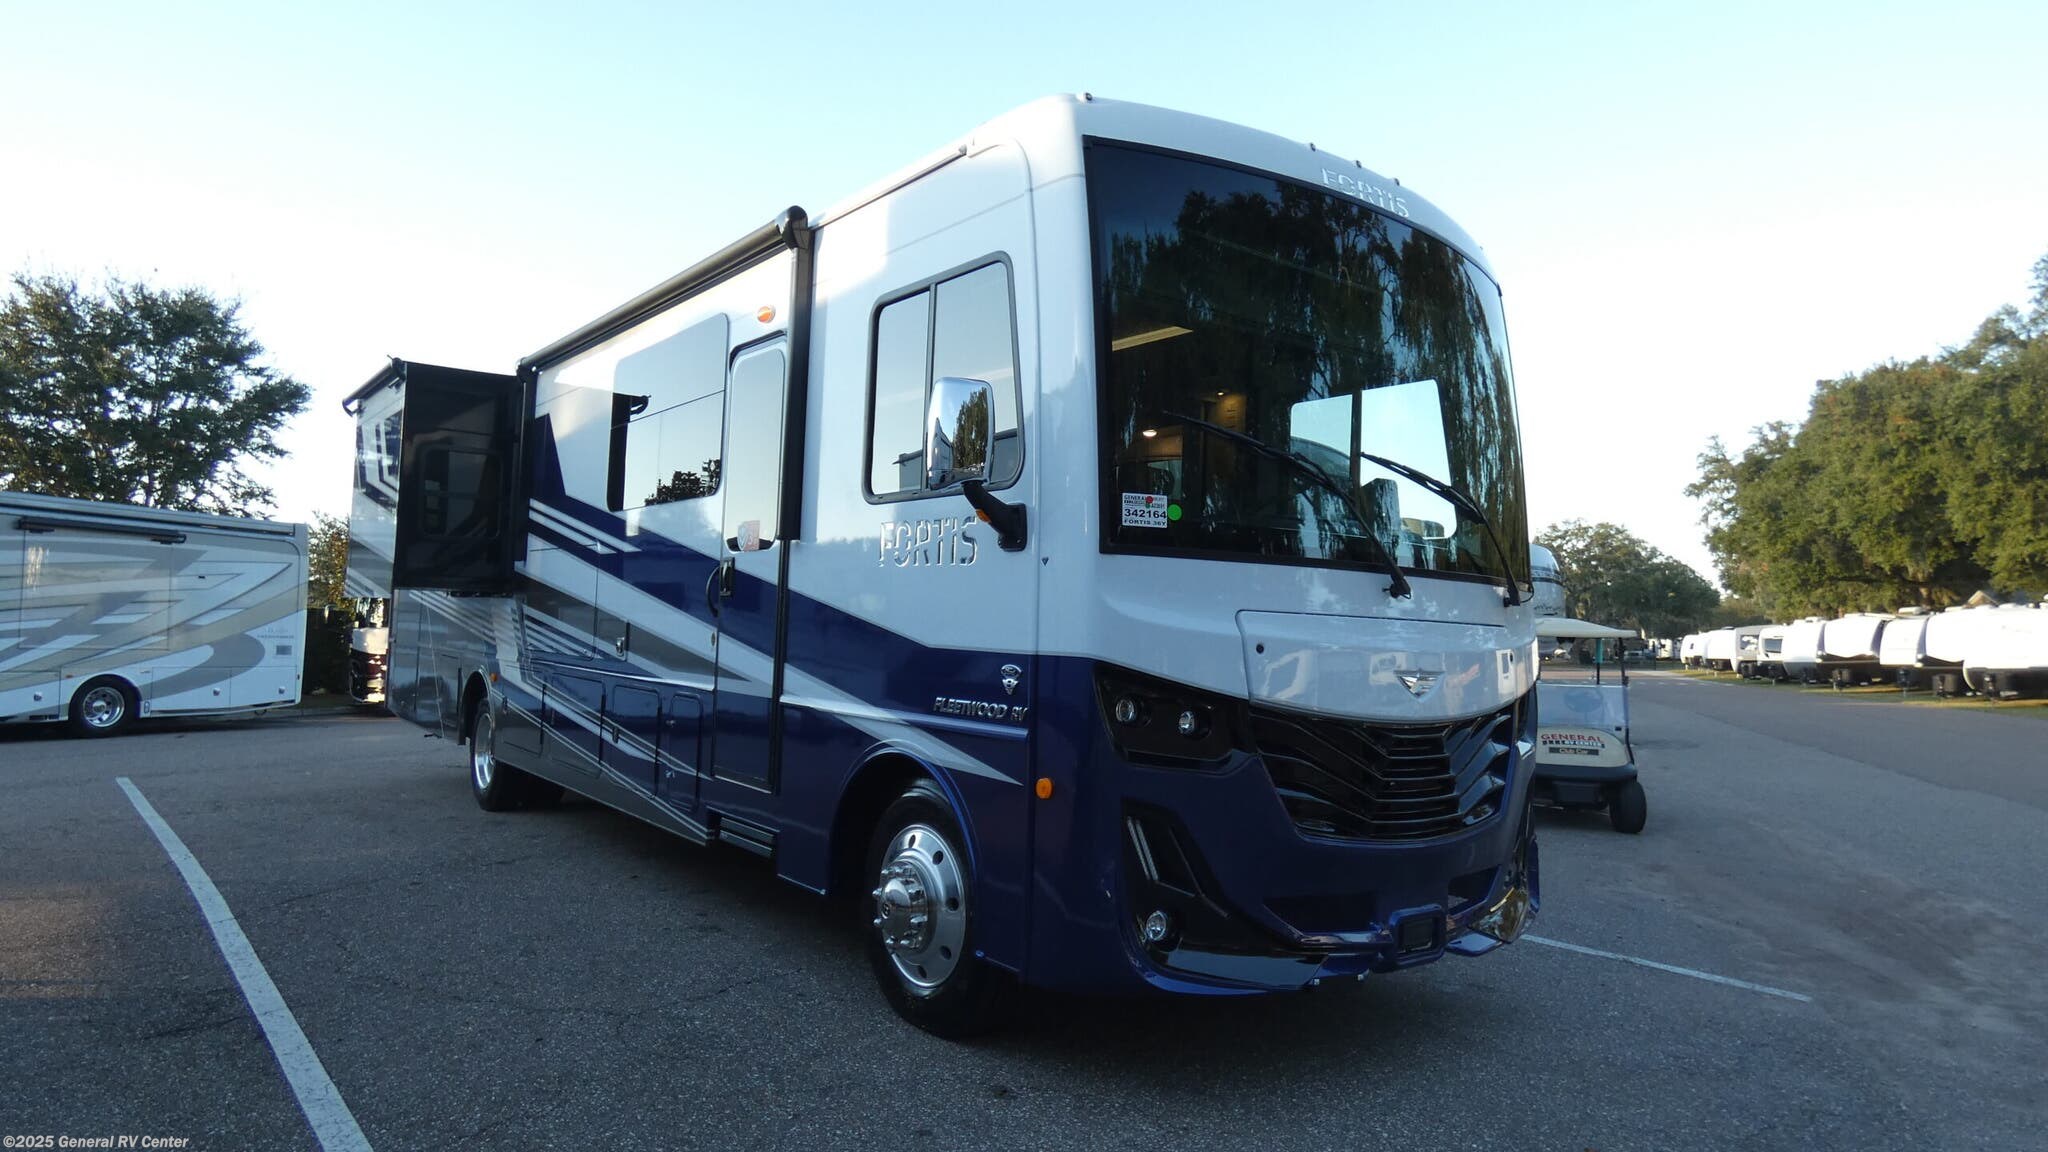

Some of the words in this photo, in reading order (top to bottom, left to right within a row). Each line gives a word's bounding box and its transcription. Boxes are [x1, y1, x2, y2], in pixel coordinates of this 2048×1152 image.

[1321, 167, 1409, 218] FORTIS
[1124, 508, 1167, 519] 342164
[879, 516, 978, 567] FORTIS
[933, 697, 1008, 718] FLEETWOOD
[1010, 706, 1028, 721] RV
[1541, 733, 1604, 743] GENERAL
